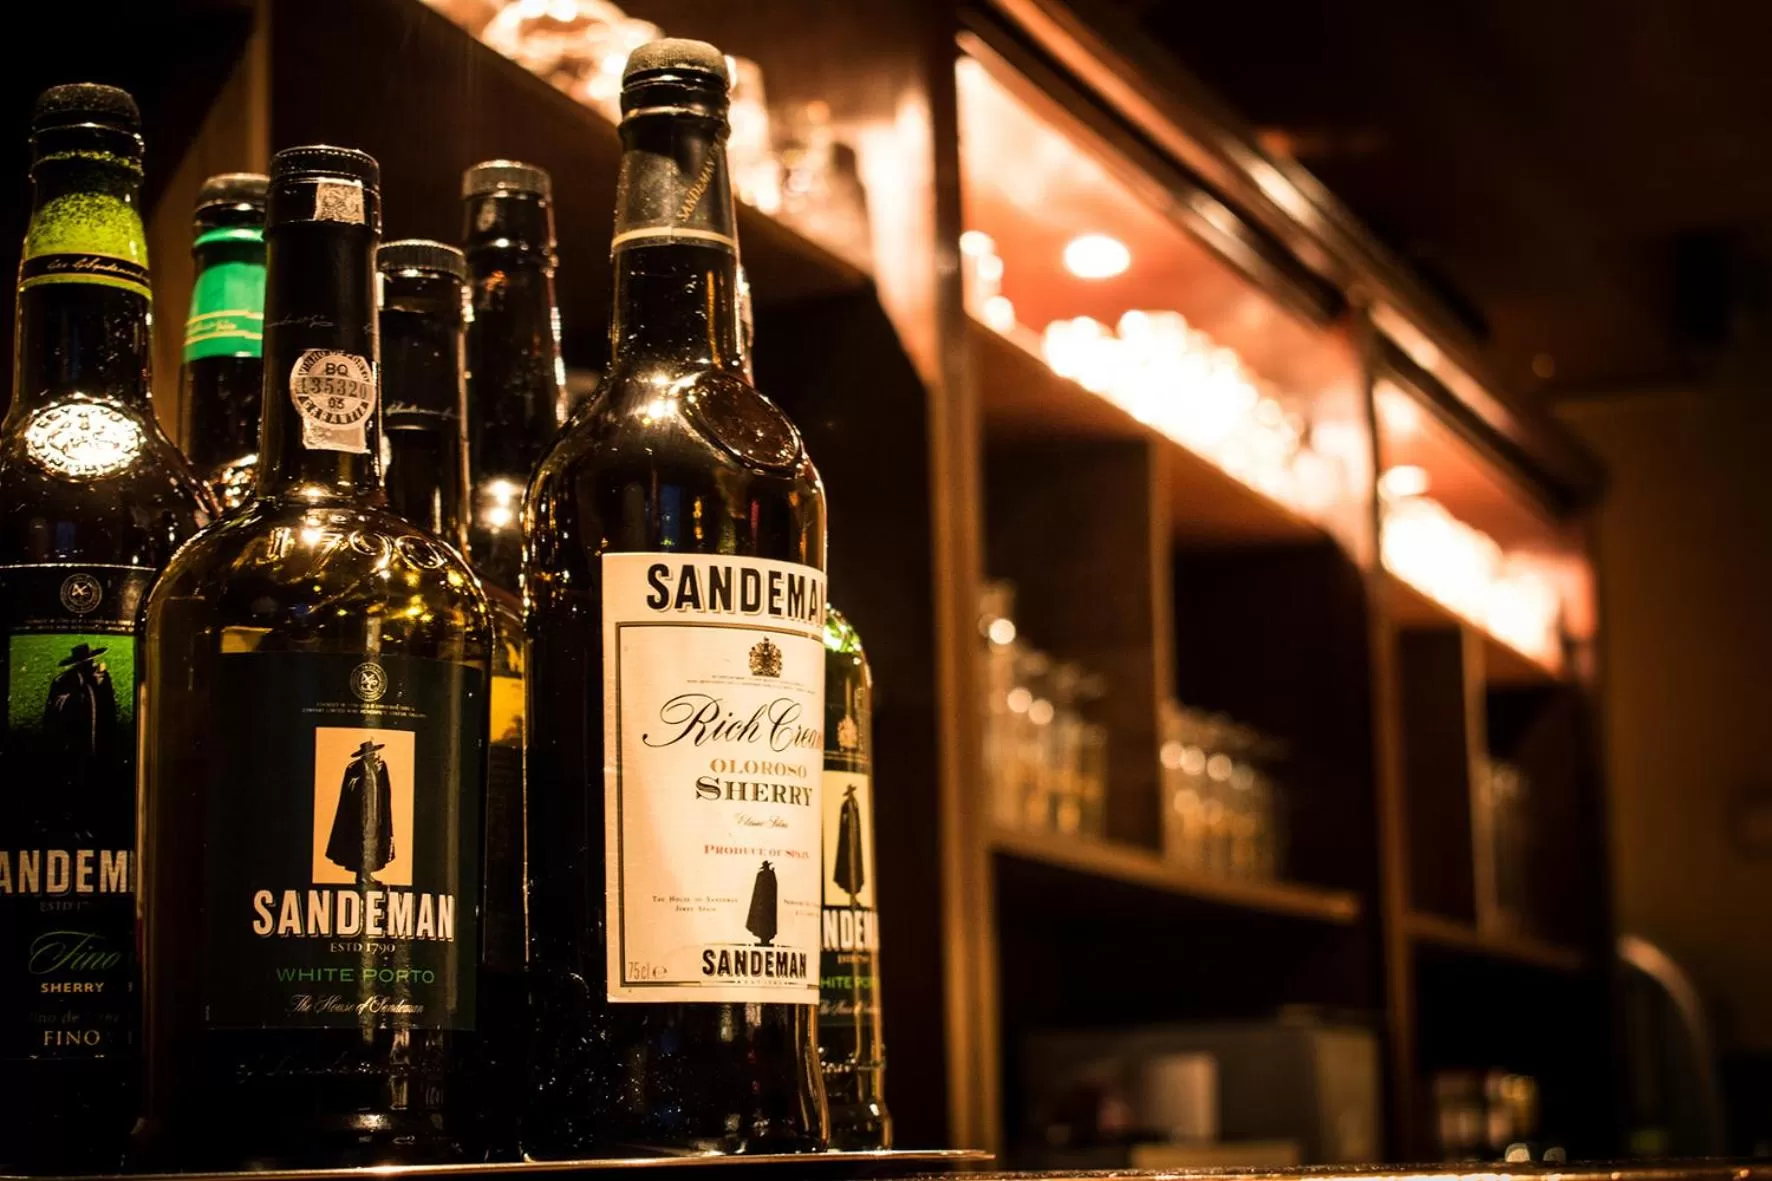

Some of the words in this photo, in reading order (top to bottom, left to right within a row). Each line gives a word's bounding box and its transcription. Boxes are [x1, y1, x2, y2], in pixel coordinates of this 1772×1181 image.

[325, 362, 349, 377] BQ
[642, 692, 768, 748] Rich
[709, 758, 808, 779] OLOROSO
[695, 775, 813, 807] SHERRY
[252, 889, 455, 941] SANDEMAN
[28, 930, 121, 975] Fino
[330, 942, 363, 953] ESTD
[366, 941, 396, 955] 1790
[628, 960, 650, 981] 75cl
[702, 948, 807, 979] SANDEMAN
[276, 967, 355, 984] WHITE
[363, 969, 436, 985] PORTO
[40, 982, 105, 993] SHERRY
[43, 1029, 101, 1046] FINO
